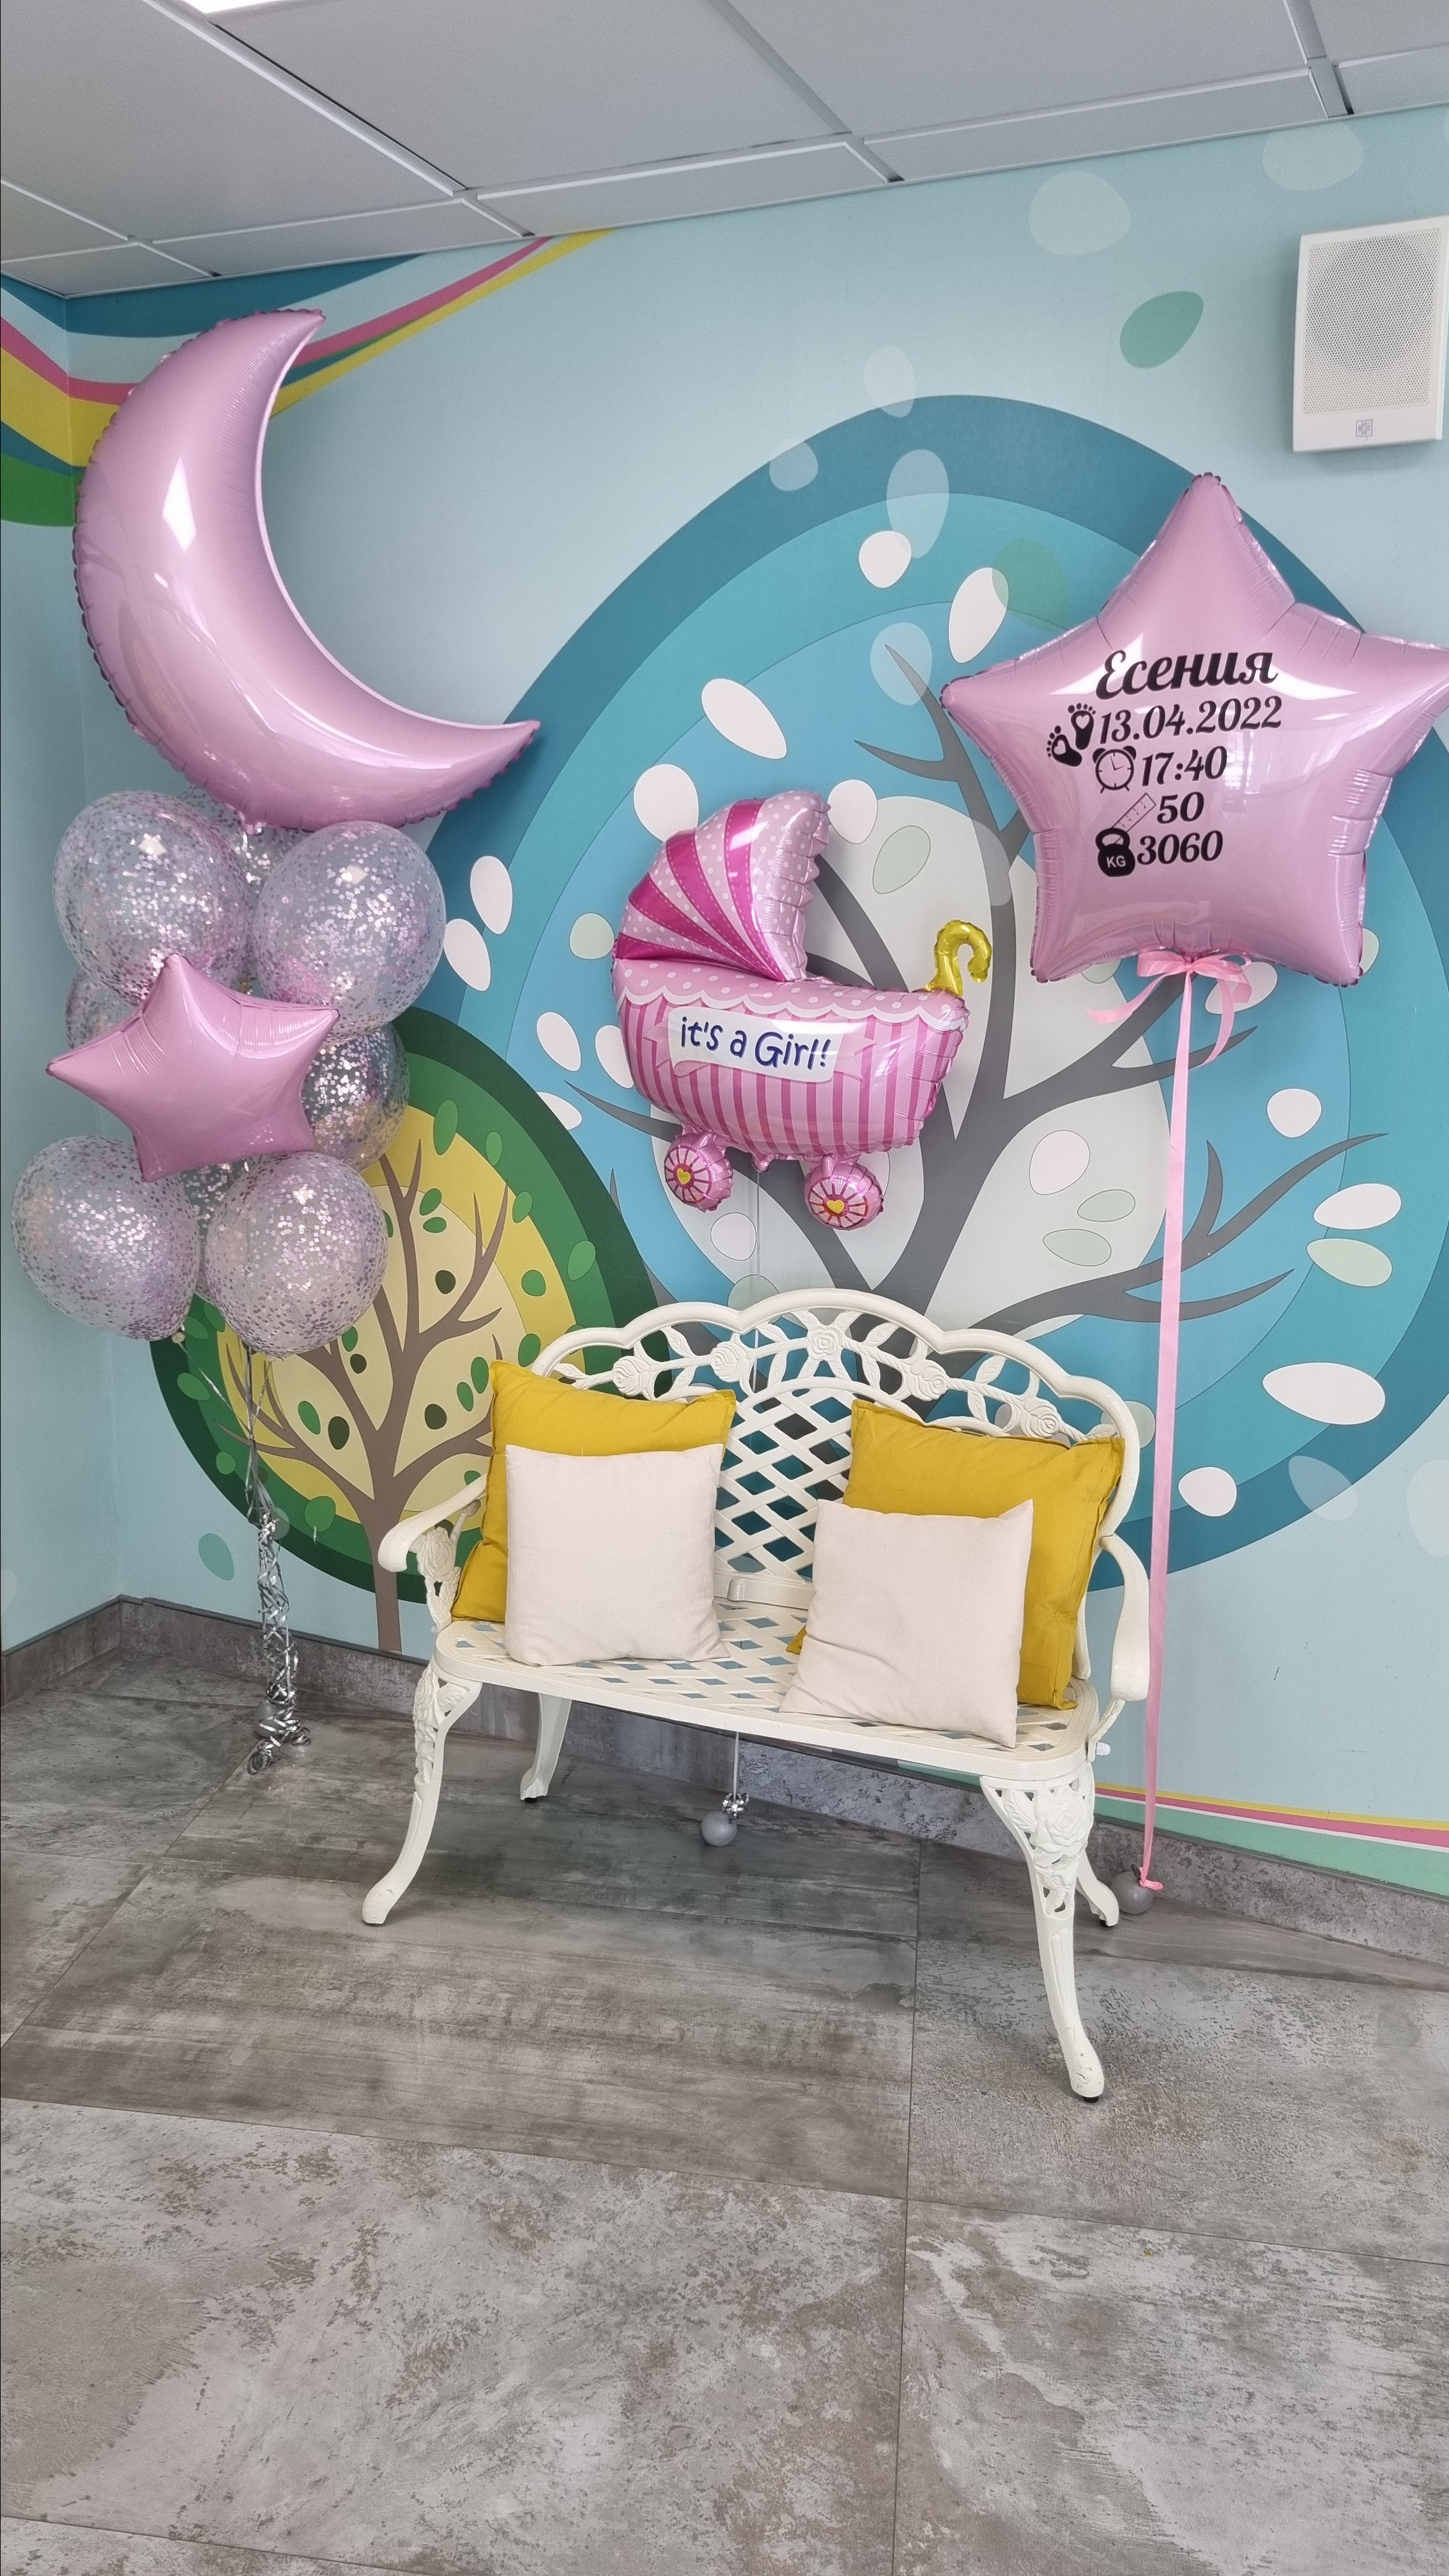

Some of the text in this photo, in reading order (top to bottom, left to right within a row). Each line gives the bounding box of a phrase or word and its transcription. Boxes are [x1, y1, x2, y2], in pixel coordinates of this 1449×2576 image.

[1095, 650, 1278, 700] Есения
[1100, 696, 1282, 744] 13.04.2022
[1142, 746, 1227, 786] 17:40
[1156, 792, 1204, 824] 50
[1106, 855, 1126, 868] KG
[1137, 831, 1223, 865] 3060
[681, 1016, 831, 1071] it's a Girl!
